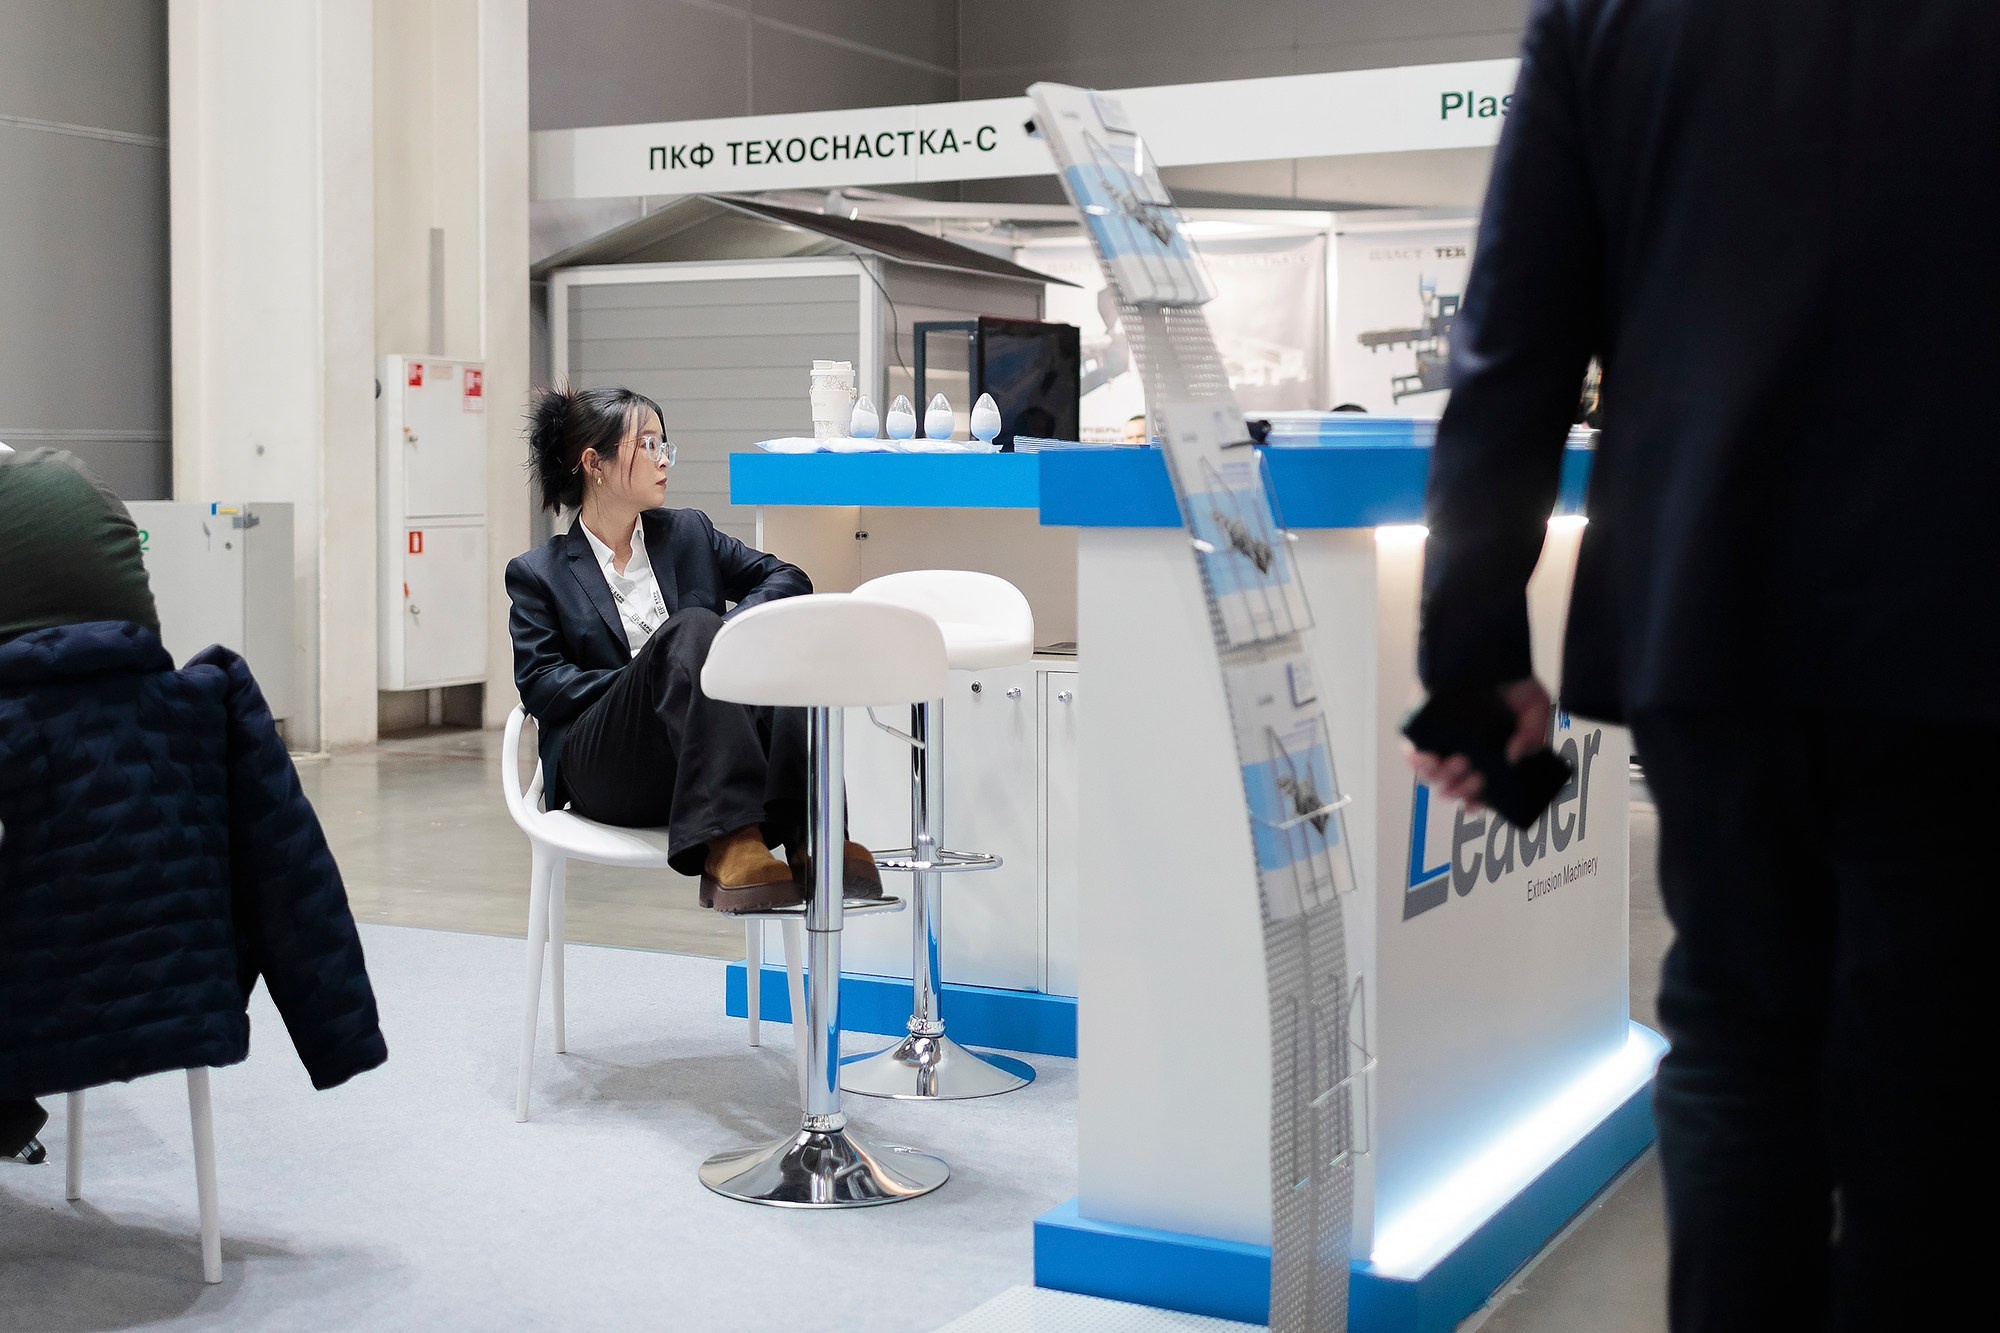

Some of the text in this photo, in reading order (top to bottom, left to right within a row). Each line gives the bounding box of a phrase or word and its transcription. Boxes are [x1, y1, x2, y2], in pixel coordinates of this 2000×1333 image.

[648, 126, 998, 171] ПКФ ТЕХОСНАСТКА-С
[1527, 856, 1599, 903] Extrusion Machinery
